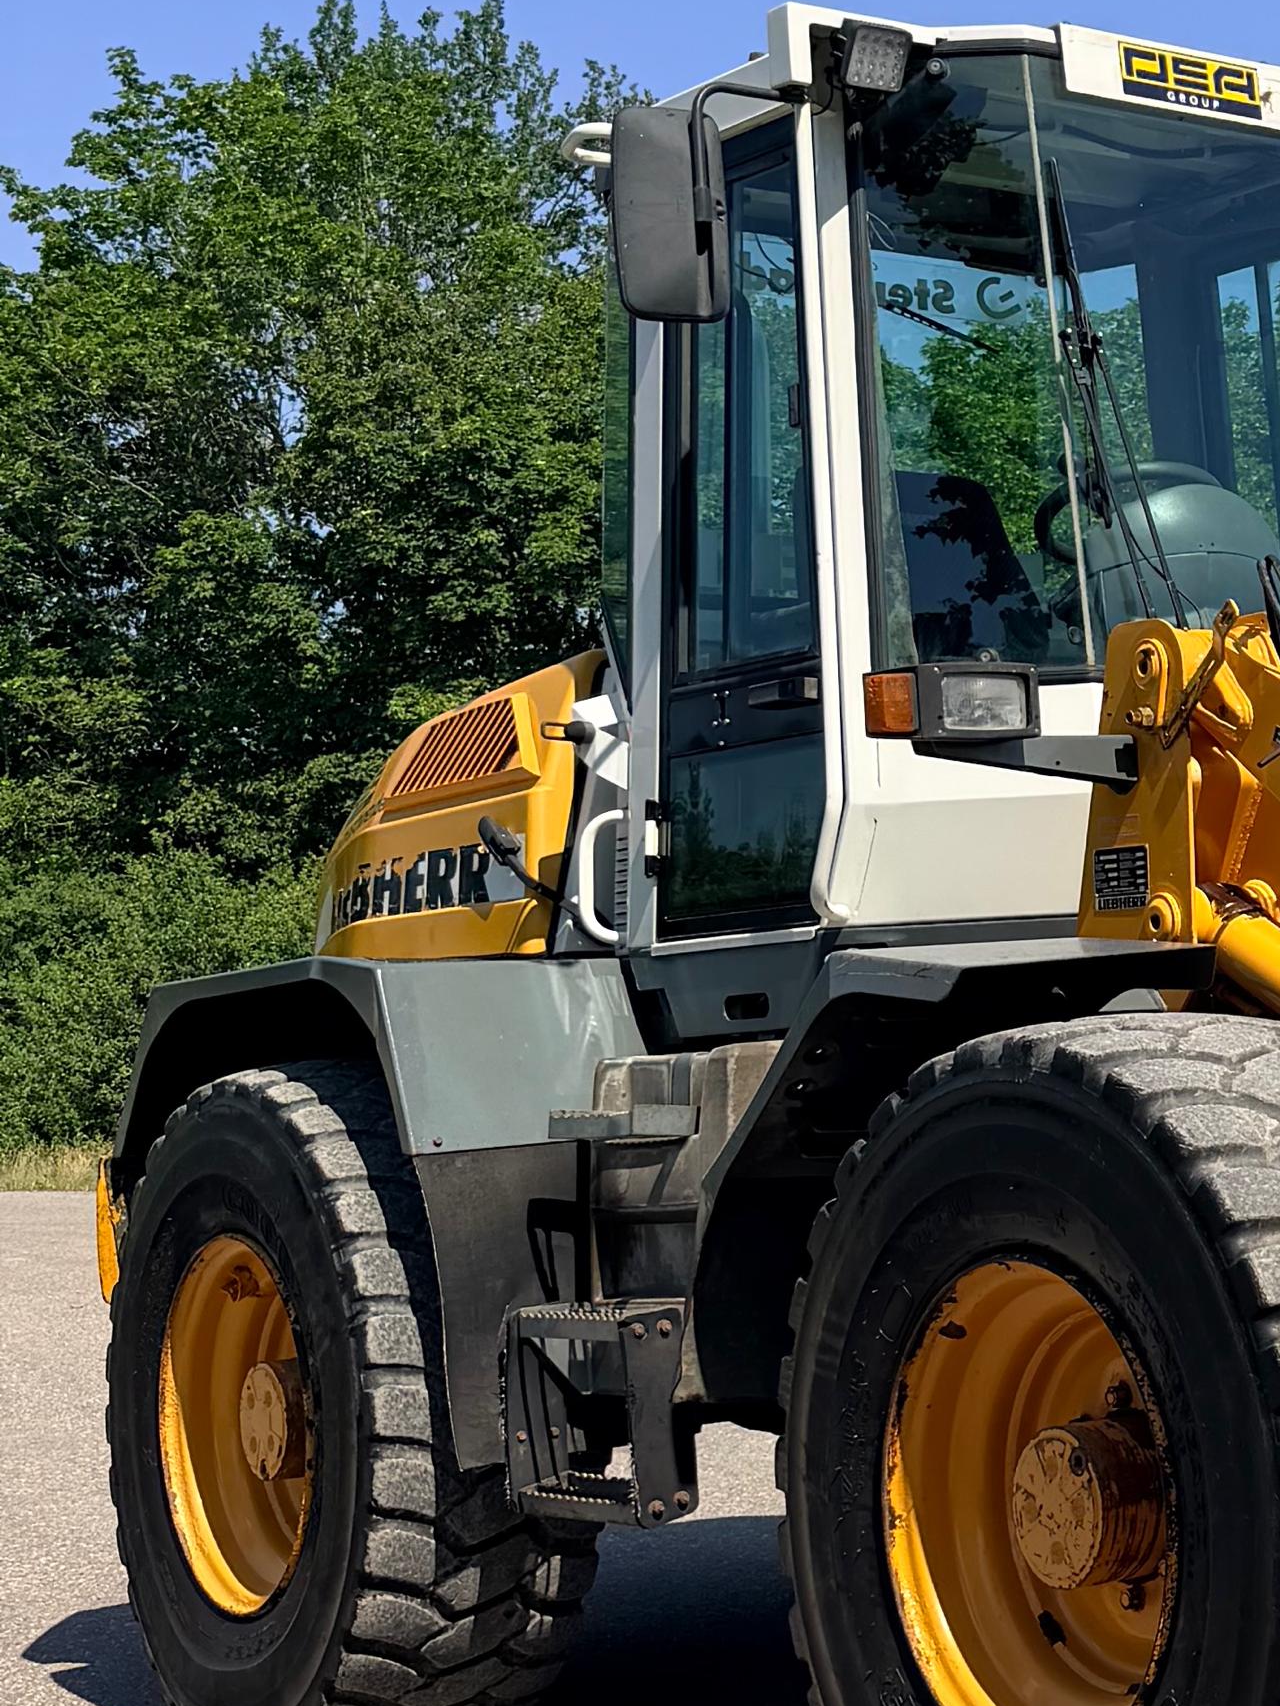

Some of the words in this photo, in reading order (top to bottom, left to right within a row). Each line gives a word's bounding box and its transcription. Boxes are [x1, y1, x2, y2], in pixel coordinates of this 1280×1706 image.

[1166, 91, 1220, 110] GROUP
[331, 842, 490, 934] EBHERR
[1098, 895, 1147, 911] LIEBHERR
